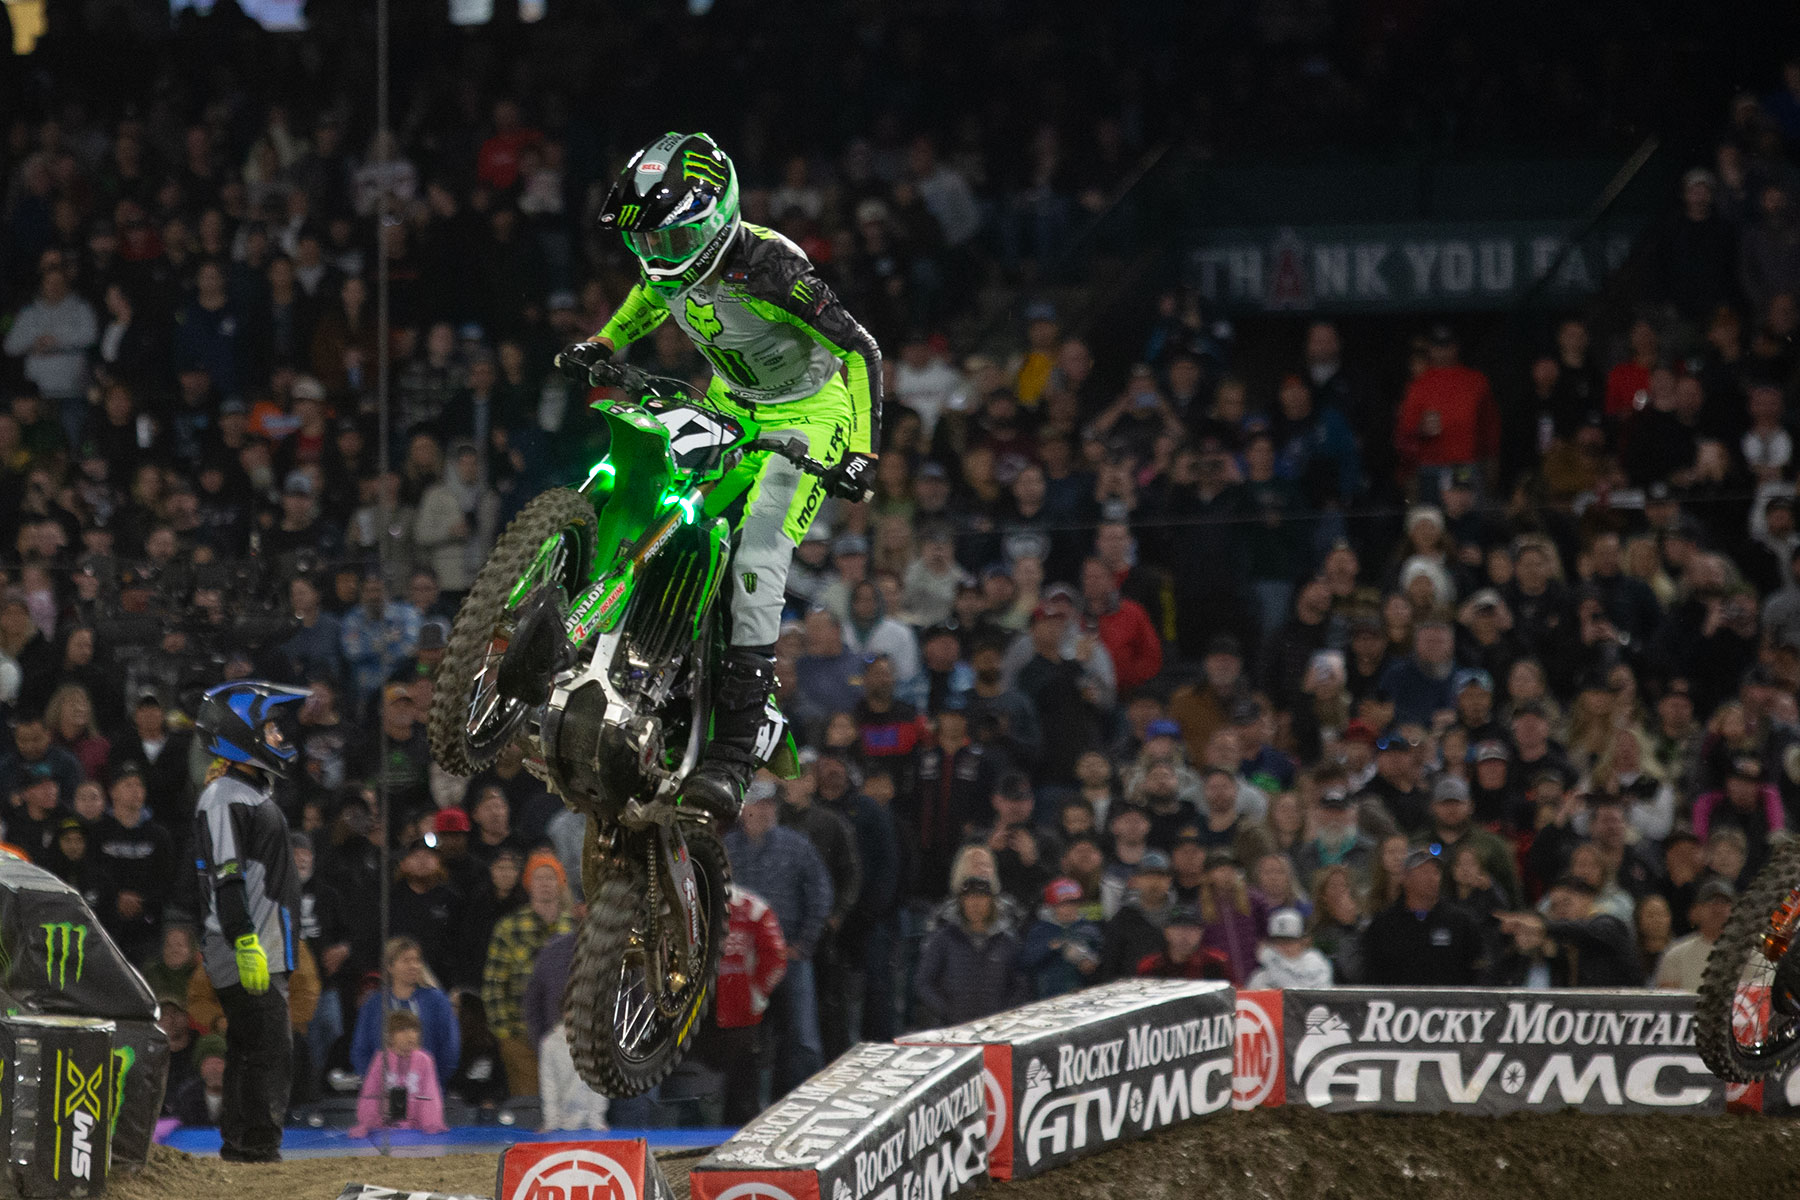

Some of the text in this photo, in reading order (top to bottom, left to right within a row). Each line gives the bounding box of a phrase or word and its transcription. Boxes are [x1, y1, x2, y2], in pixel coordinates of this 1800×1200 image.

[641, 163, 662, 172] BELL
[1194, 228, 1389, 310] THANK
[1405, 239, 1514, 295] YOU
[845, 456, 869, 480] FOX
[565, 582, 606, 635] DUNLOP
[600, 582, 626, 616] BRAKING
[1358, 1001, 1497, 1046] ROCKY
[1055, 1012, 1236, 1090] ROCKY MOUNTAIN
[854, 1073, 986, 1200] ROCKY MOUNTAIN
